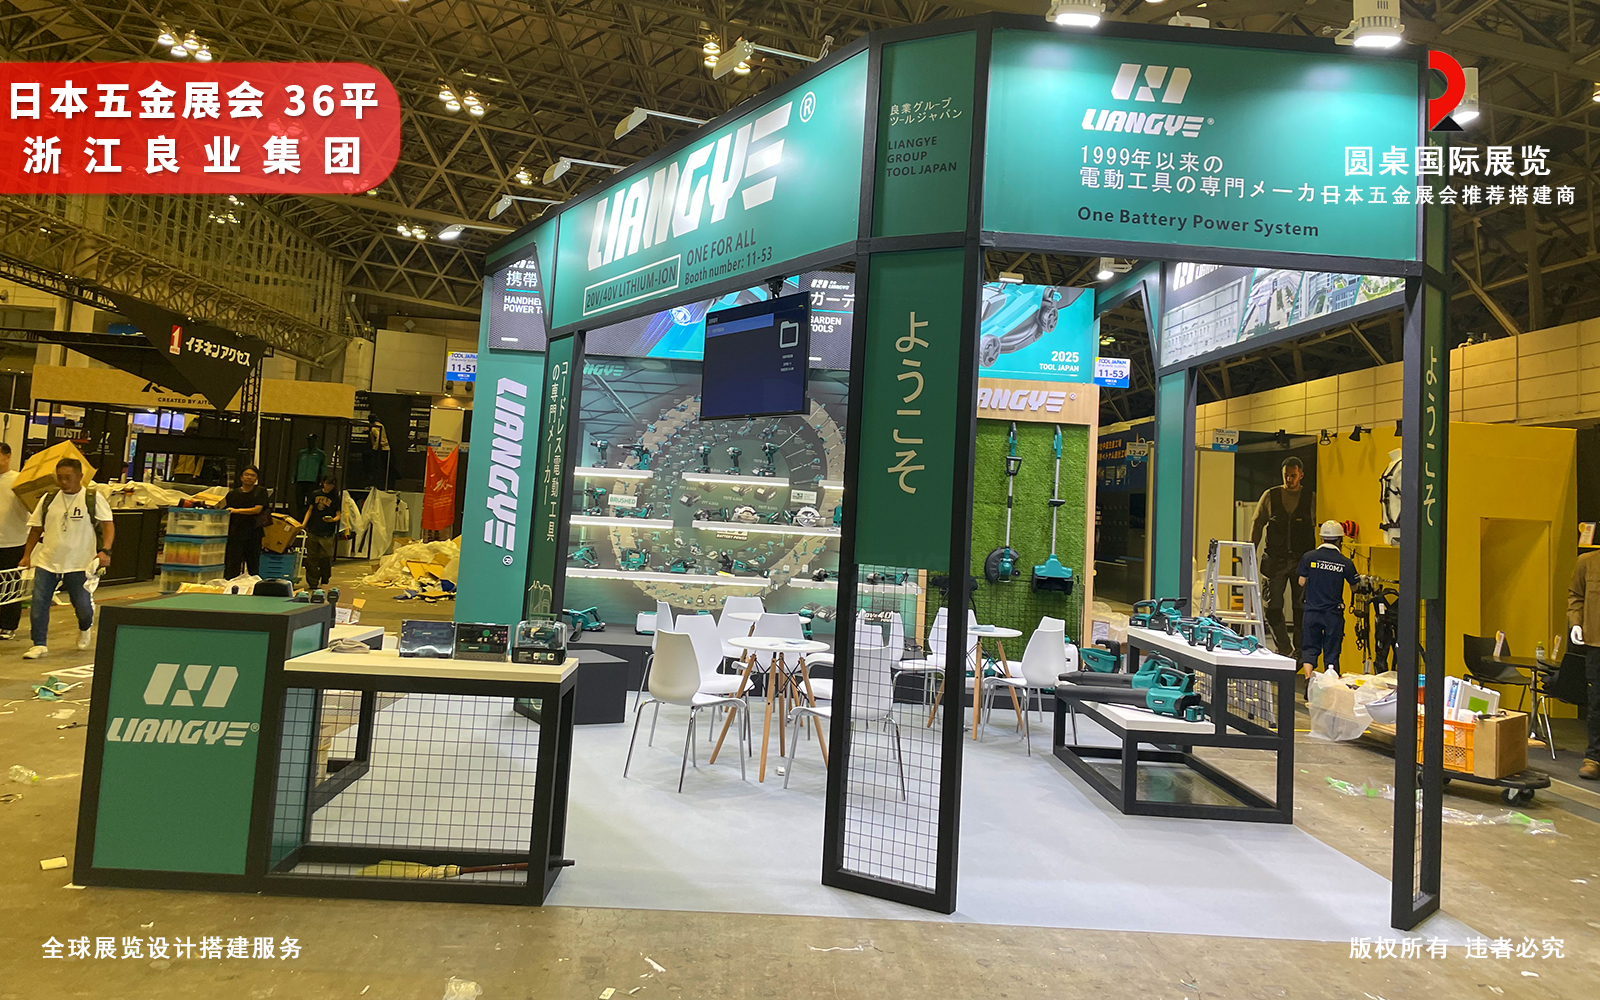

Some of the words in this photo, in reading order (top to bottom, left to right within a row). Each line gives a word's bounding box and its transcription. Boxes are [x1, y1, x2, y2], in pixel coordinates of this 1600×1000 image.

[889, 108, 963, 127] ツールジャパン
[1081, 108, 1205, 138] LIANGYE
[886, 151, 928, 164] GROUP
[888, 136, 938, 150] LIANGYE
[886, 166, 916, 177] TOOL
[918, 161, 958, 175] JAPAN
[1081, 145, 1224, 174] 1999年以来の
[588, 101, 793, 271] LIANGYE
[1077, 206, 1114, 222] One
[1119, 209, 1188, 231] Battery
[1193, 214, 1249, 232] Power
[1253, 219, 1319, 237] System
[686, 248, 708, 267] ONE
[710, 237, 733, 259] FOR
[734, 227, 757, 251] ALL
[684, 269, 708, 286] Booth
[708, 257, 745, 281] number:
[746, 246, 773, 268] 11-53
[586, 285, 618, 308] 20V/40V
[618, 264, 677, 299] LITHIUM-ION
[503, 303, 534, 313] POWER
[185, 337, 251, 367] イチネンアクセス
[1051, 350, 1080, 363] 2025
[451, 363, 476, 373] 11-51
[1039, 363, 1056, 371] TOOL
[1099, 369, 1124, 378] 11-53
[887, 311, 930, 495] ようこそ
[977, 387, 1067, 413] ANGYE
[543, 364, 560, 506] の専門メーカー
[1215, 436, 1234, 445] 12-51
[1423, 346, 1438, 527] ようこそ
[484, 377, 528, 552] LIANGYE
[106, 717, 250, 747] LIANGYE
